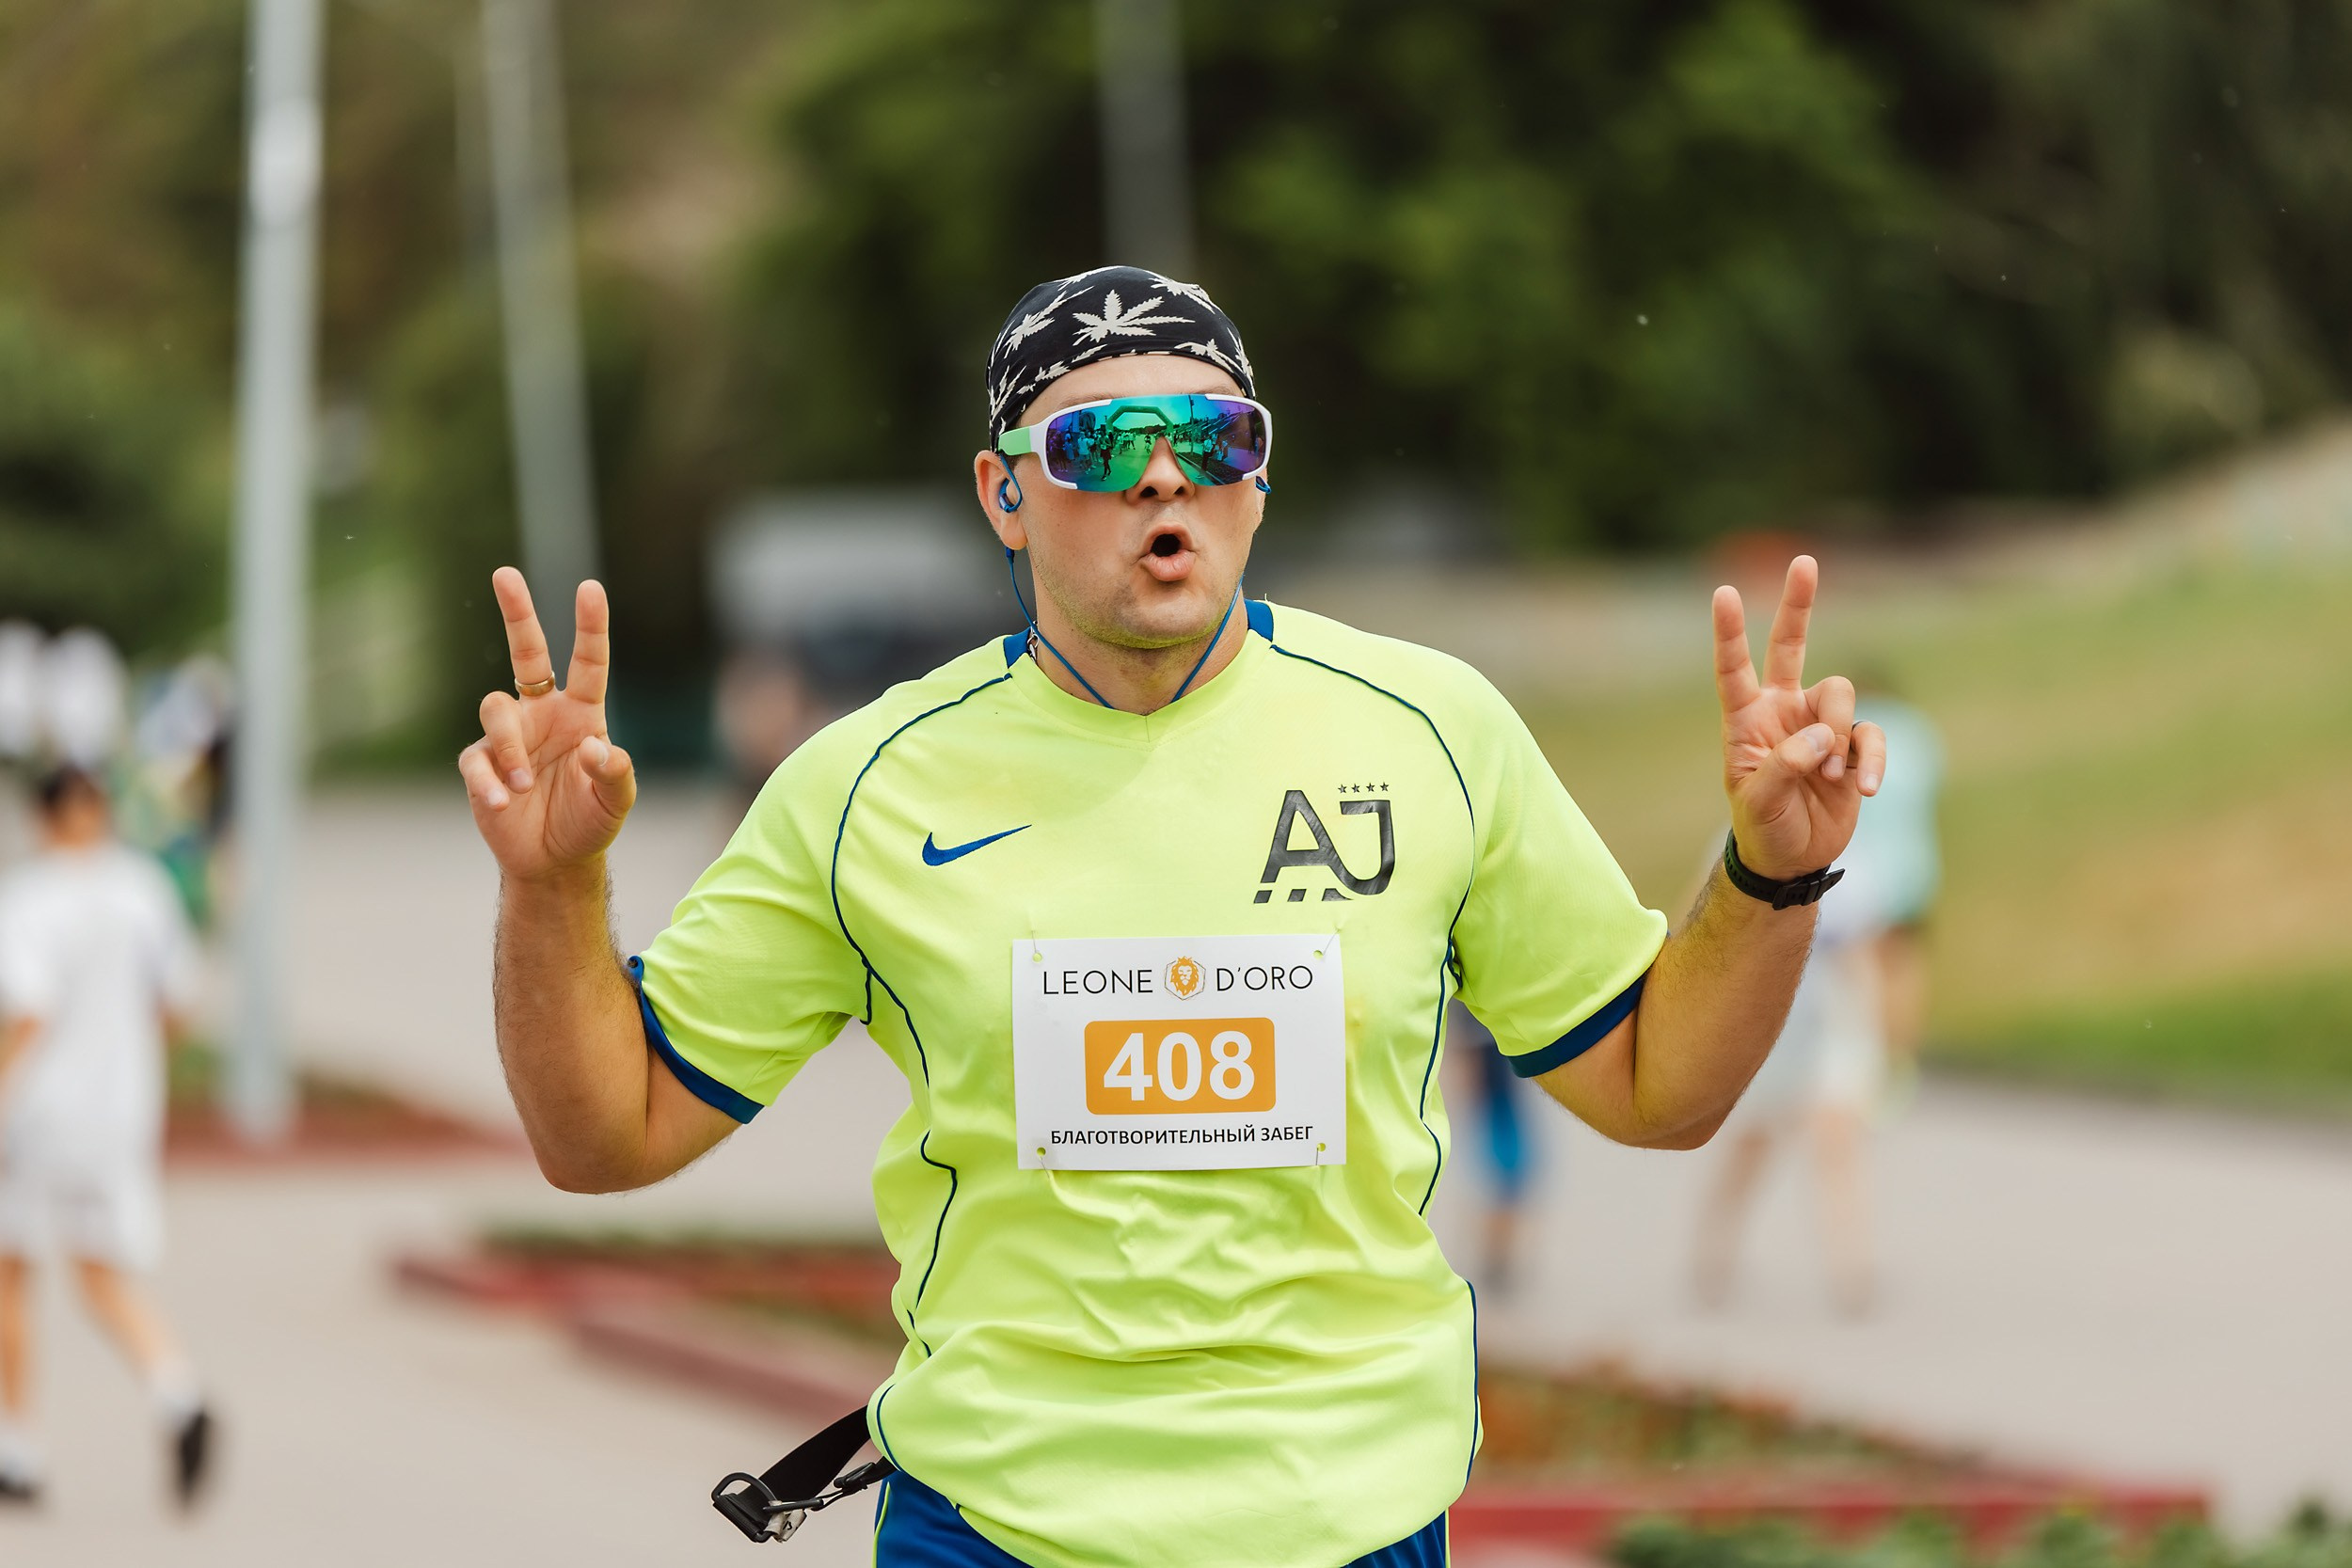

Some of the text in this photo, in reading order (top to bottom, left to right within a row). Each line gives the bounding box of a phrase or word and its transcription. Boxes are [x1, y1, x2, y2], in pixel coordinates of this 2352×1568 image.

[1260, 789, 1396, 895] AJ
[1042, 965, 1313, 995] LEONE D'ORO
[1104, 1030, 1255, 1101] 408
[1050, 1124, 1313, 1146] БЛАГОТВОРИТЕЛЬНЫЙ ЗАБЕГ
